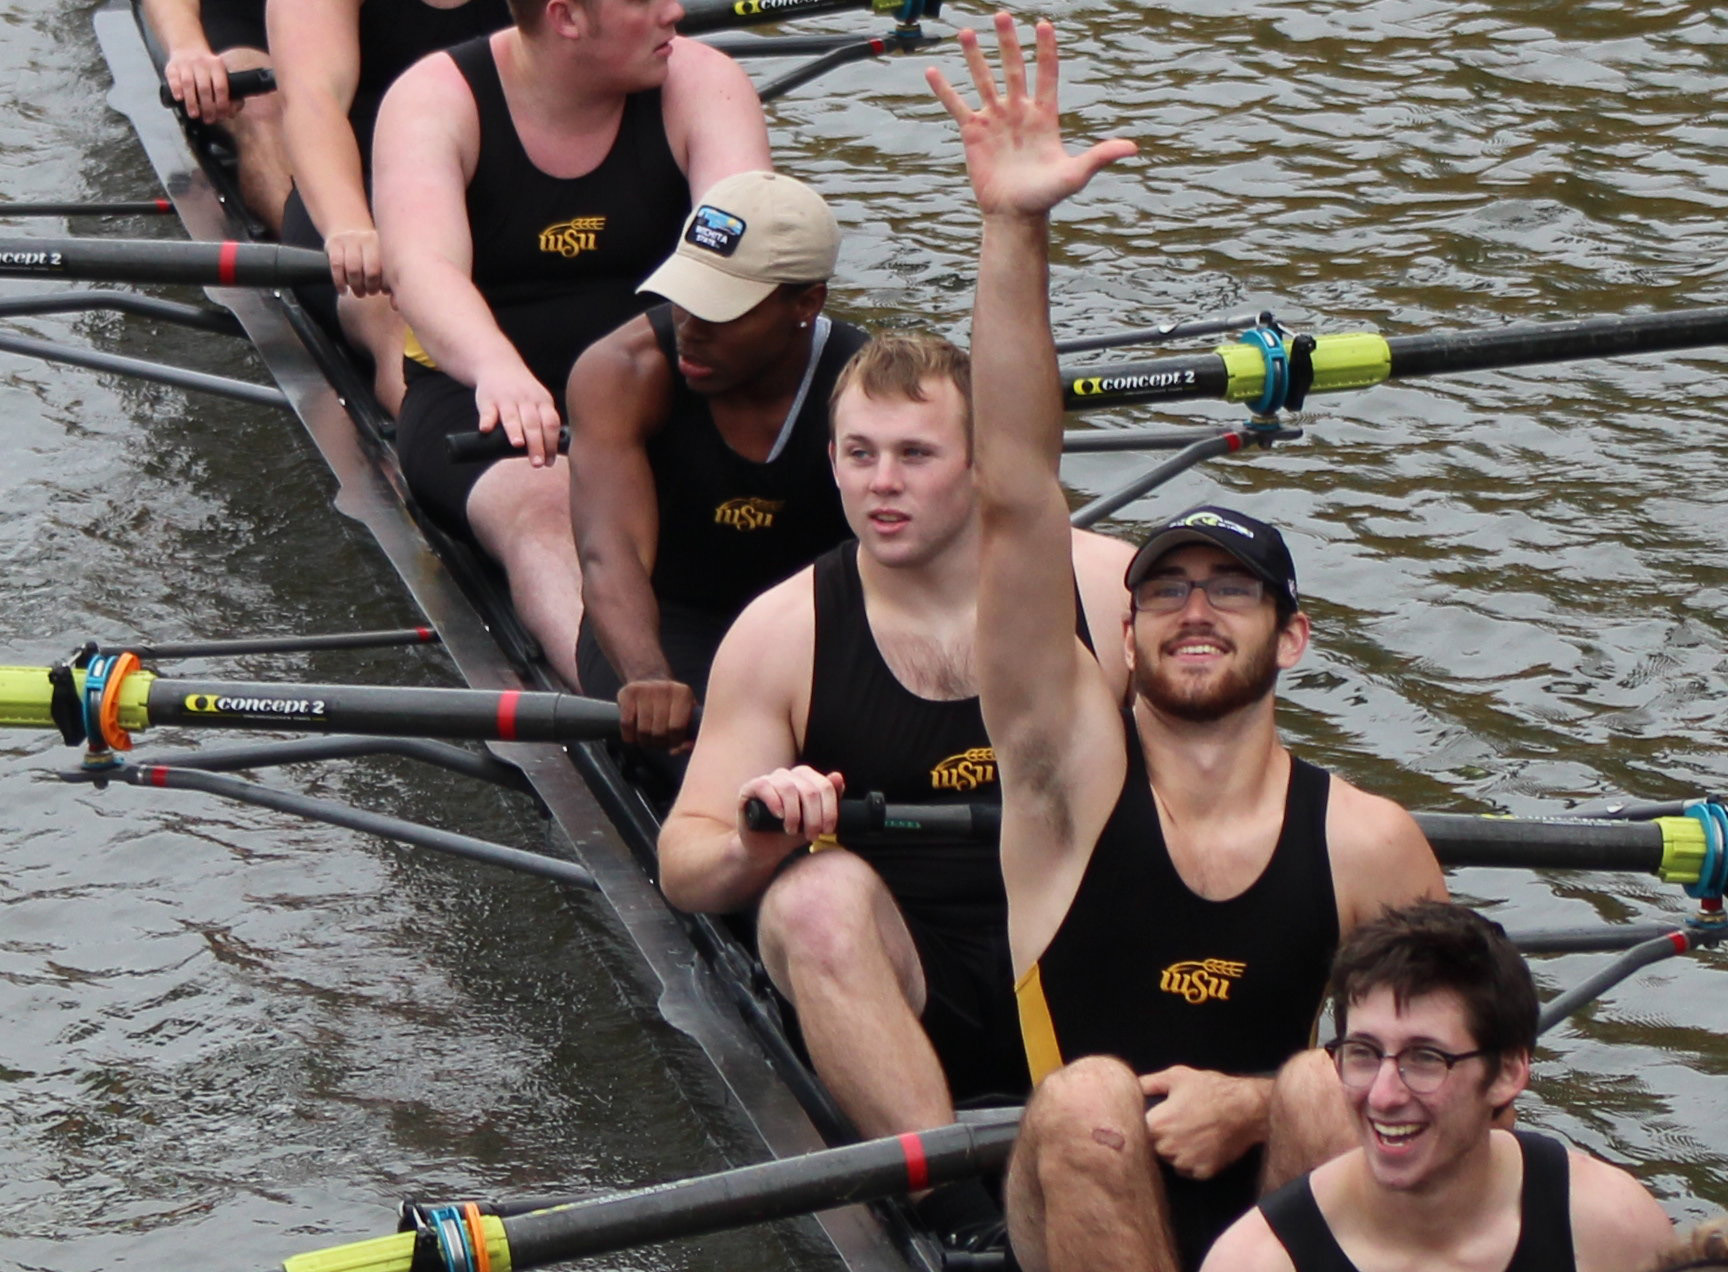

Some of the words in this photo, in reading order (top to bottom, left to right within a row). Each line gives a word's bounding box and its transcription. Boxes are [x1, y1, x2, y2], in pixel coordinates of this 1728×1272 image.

[50, 252, 62, 265] 2
[1102, 372, 1181, 391] concept
[1184, 370, 1195, 384] 2
[217, 697, 309, 714] concept
[312, 700, 325, 714] 2
